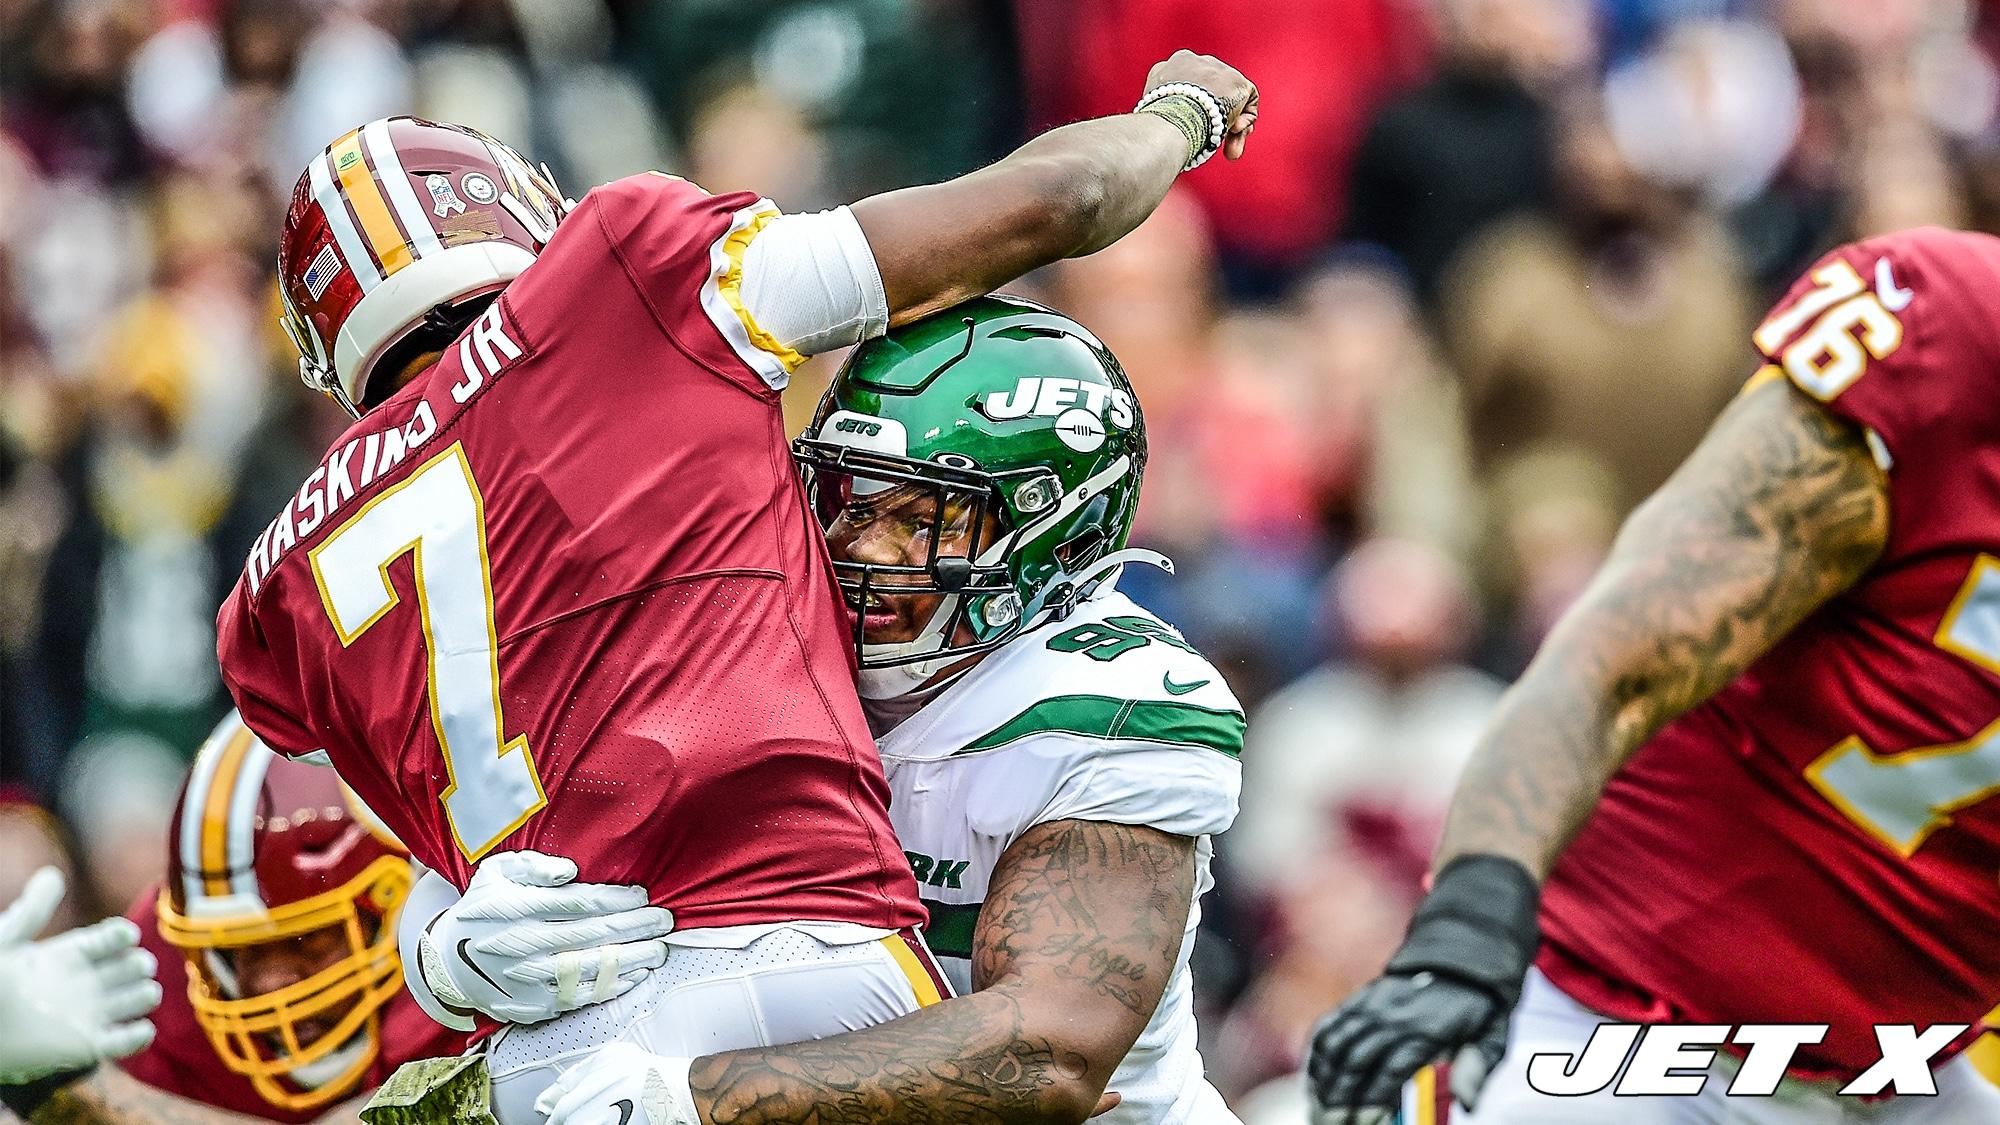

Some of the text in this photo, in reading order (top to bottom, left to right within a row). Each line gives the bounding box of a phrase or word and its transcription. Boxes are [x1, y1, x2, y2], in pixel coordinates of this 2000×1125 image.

[437, 192, 454, 204] NFL
[1752, 257, 1903, 403] 76
[246, 302, 523, 597] HASKINS JR
[835, 418, 882, 437] JETS
[984, 376, 1135, 430] JETS
[308, 440, 548, 865] 7
